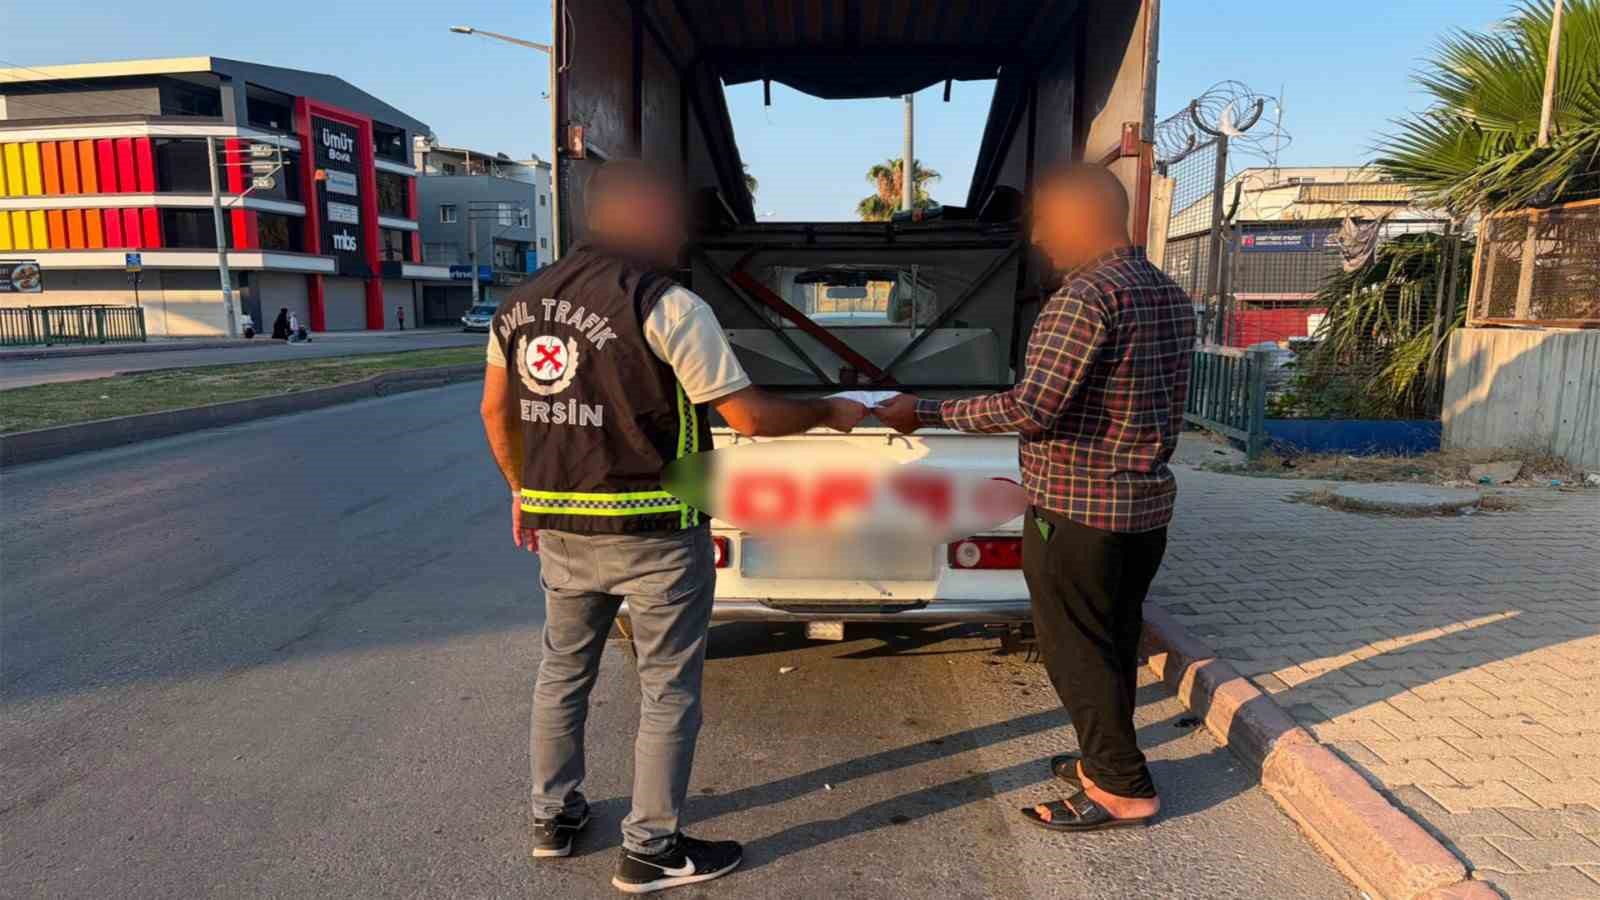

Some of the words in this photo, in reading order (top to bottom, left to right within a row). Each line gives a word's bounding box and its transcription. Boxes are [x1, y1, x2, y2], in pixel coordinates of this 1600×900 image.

[332, 229, 357, 251] mbs
[541, 298, 617, 351] TRAFİK
[519, 398, 604, 427] ERSİN
